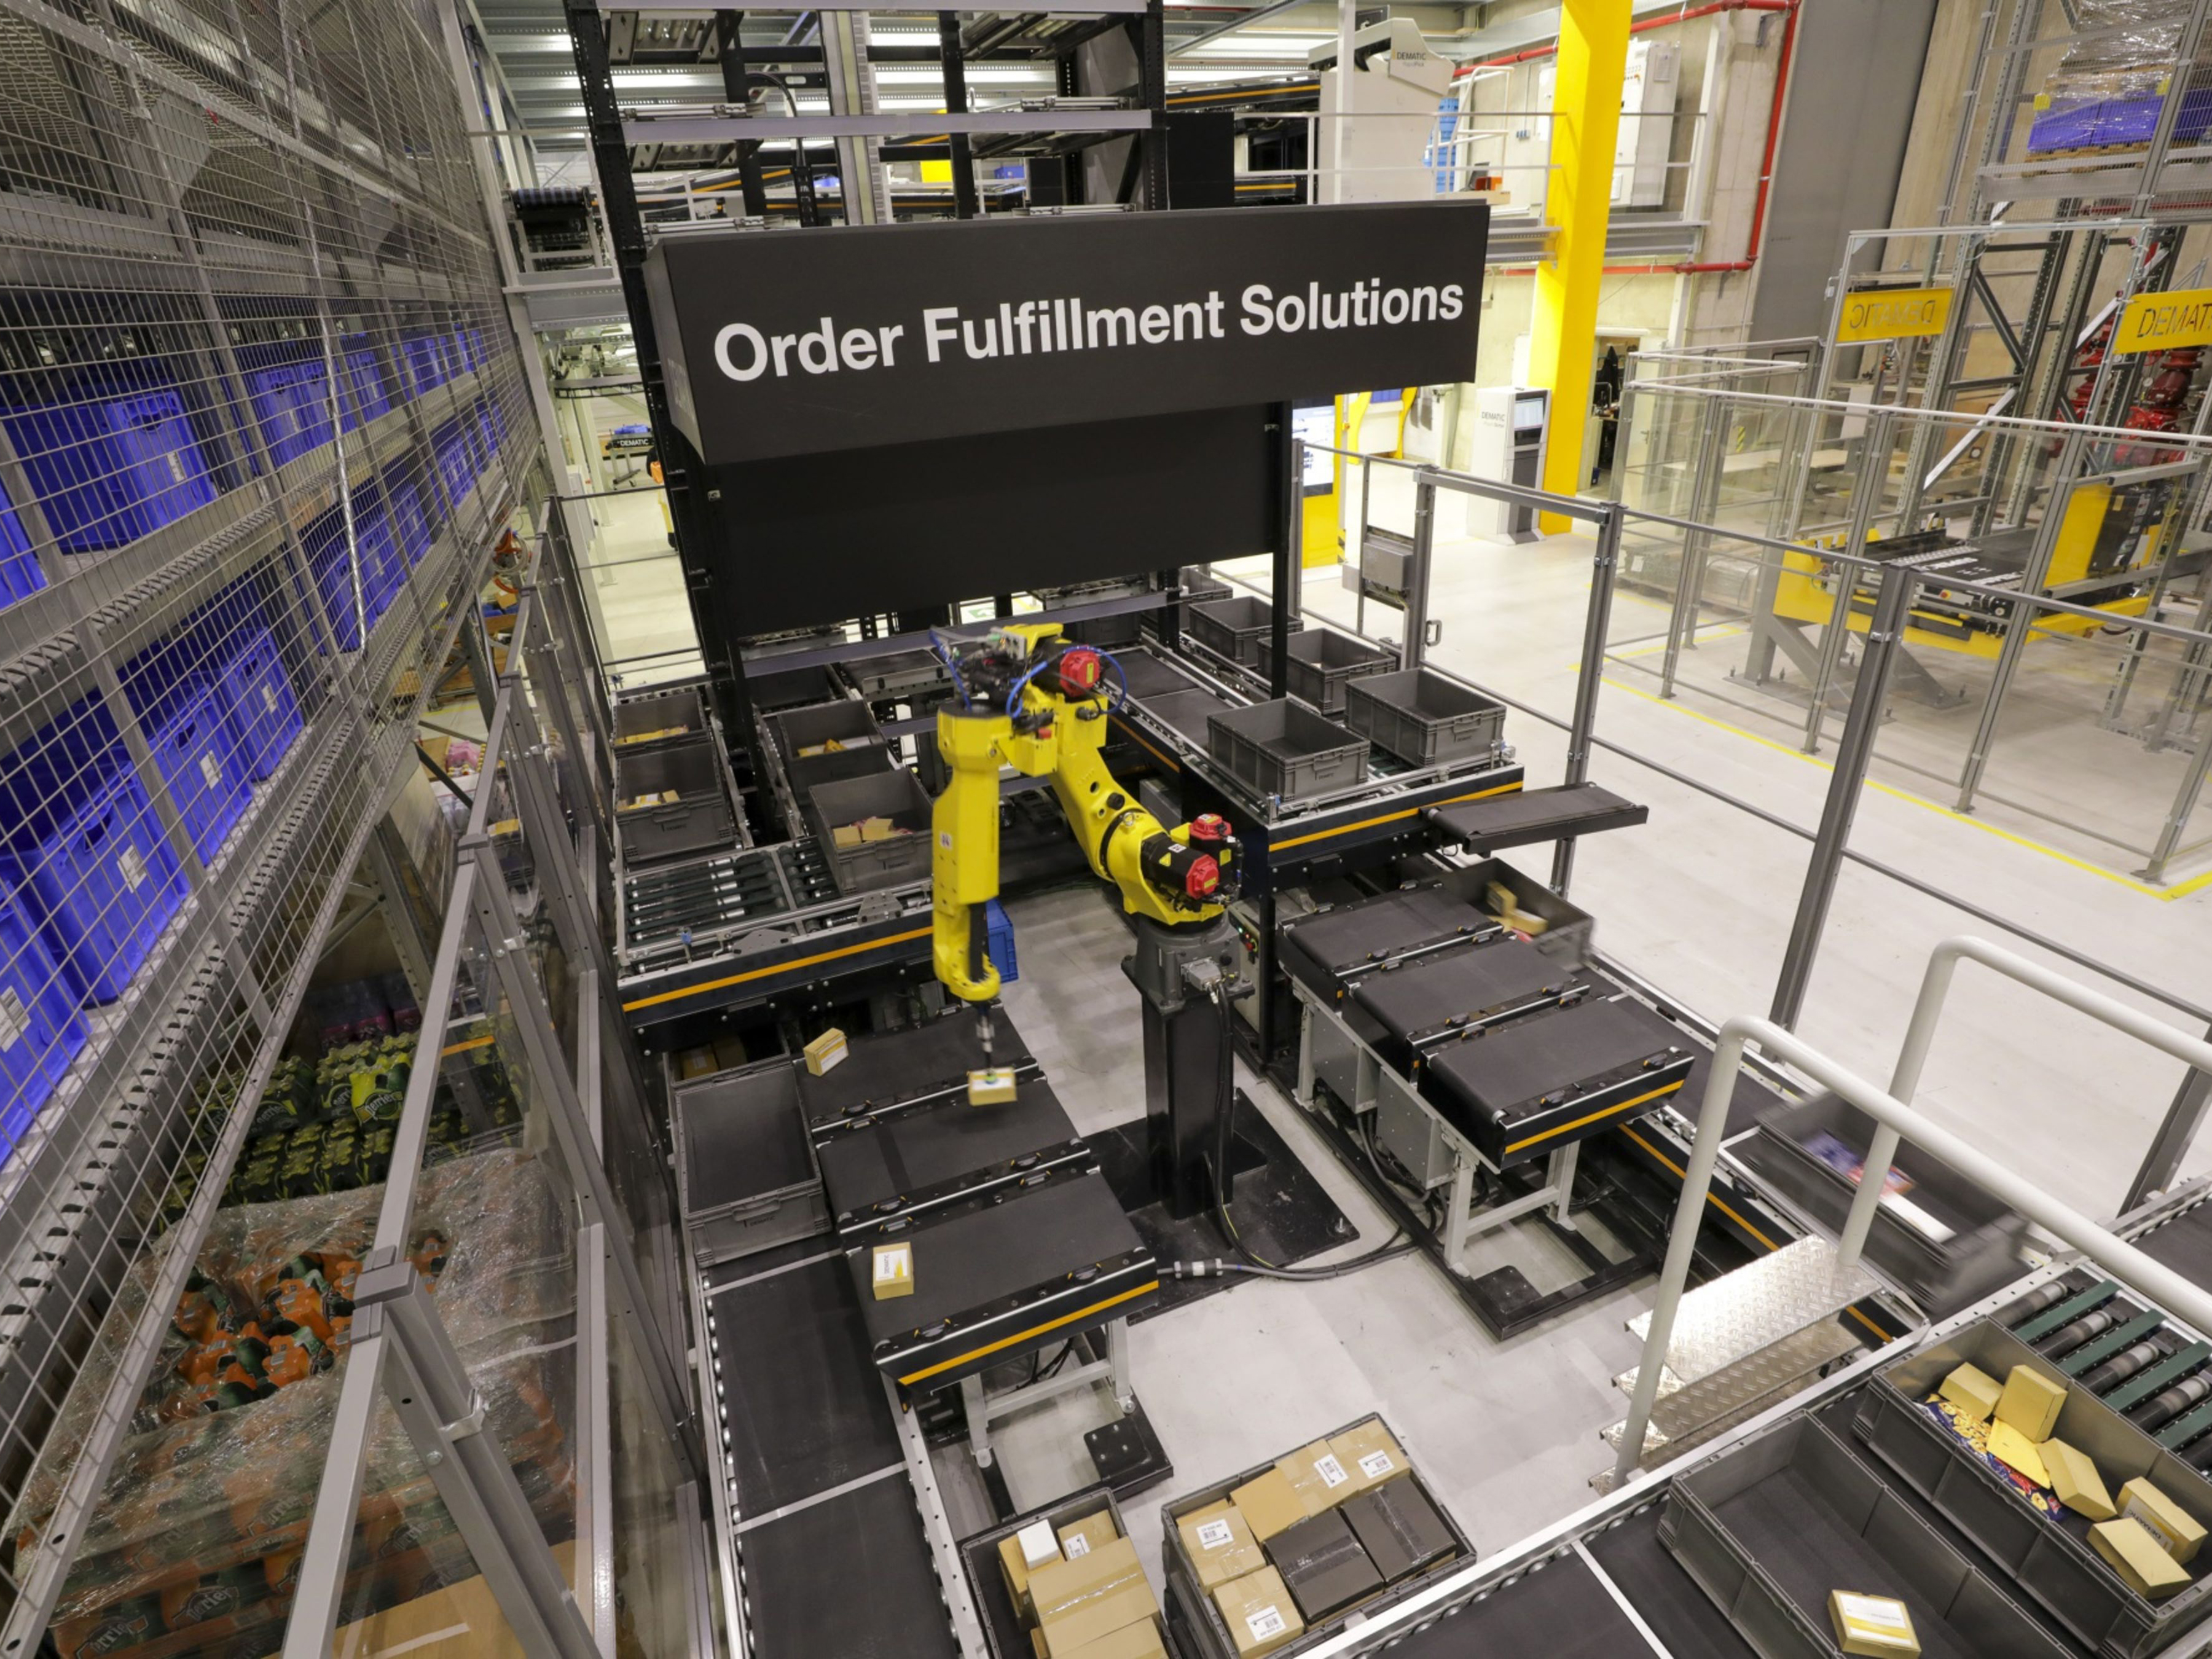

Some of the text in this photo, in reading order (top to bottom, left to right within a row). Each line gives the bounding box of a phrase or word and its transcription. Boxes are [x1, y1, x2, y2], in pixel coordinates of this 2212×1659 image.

[1397, 52, 1426, 60] DEMATIC
[715, 277, 1463, 382] Order Fulfillment Solutions
[2137, 304, 2212, 337] DEMAT
[1481, 412, 1505, 422] DEMATIC
